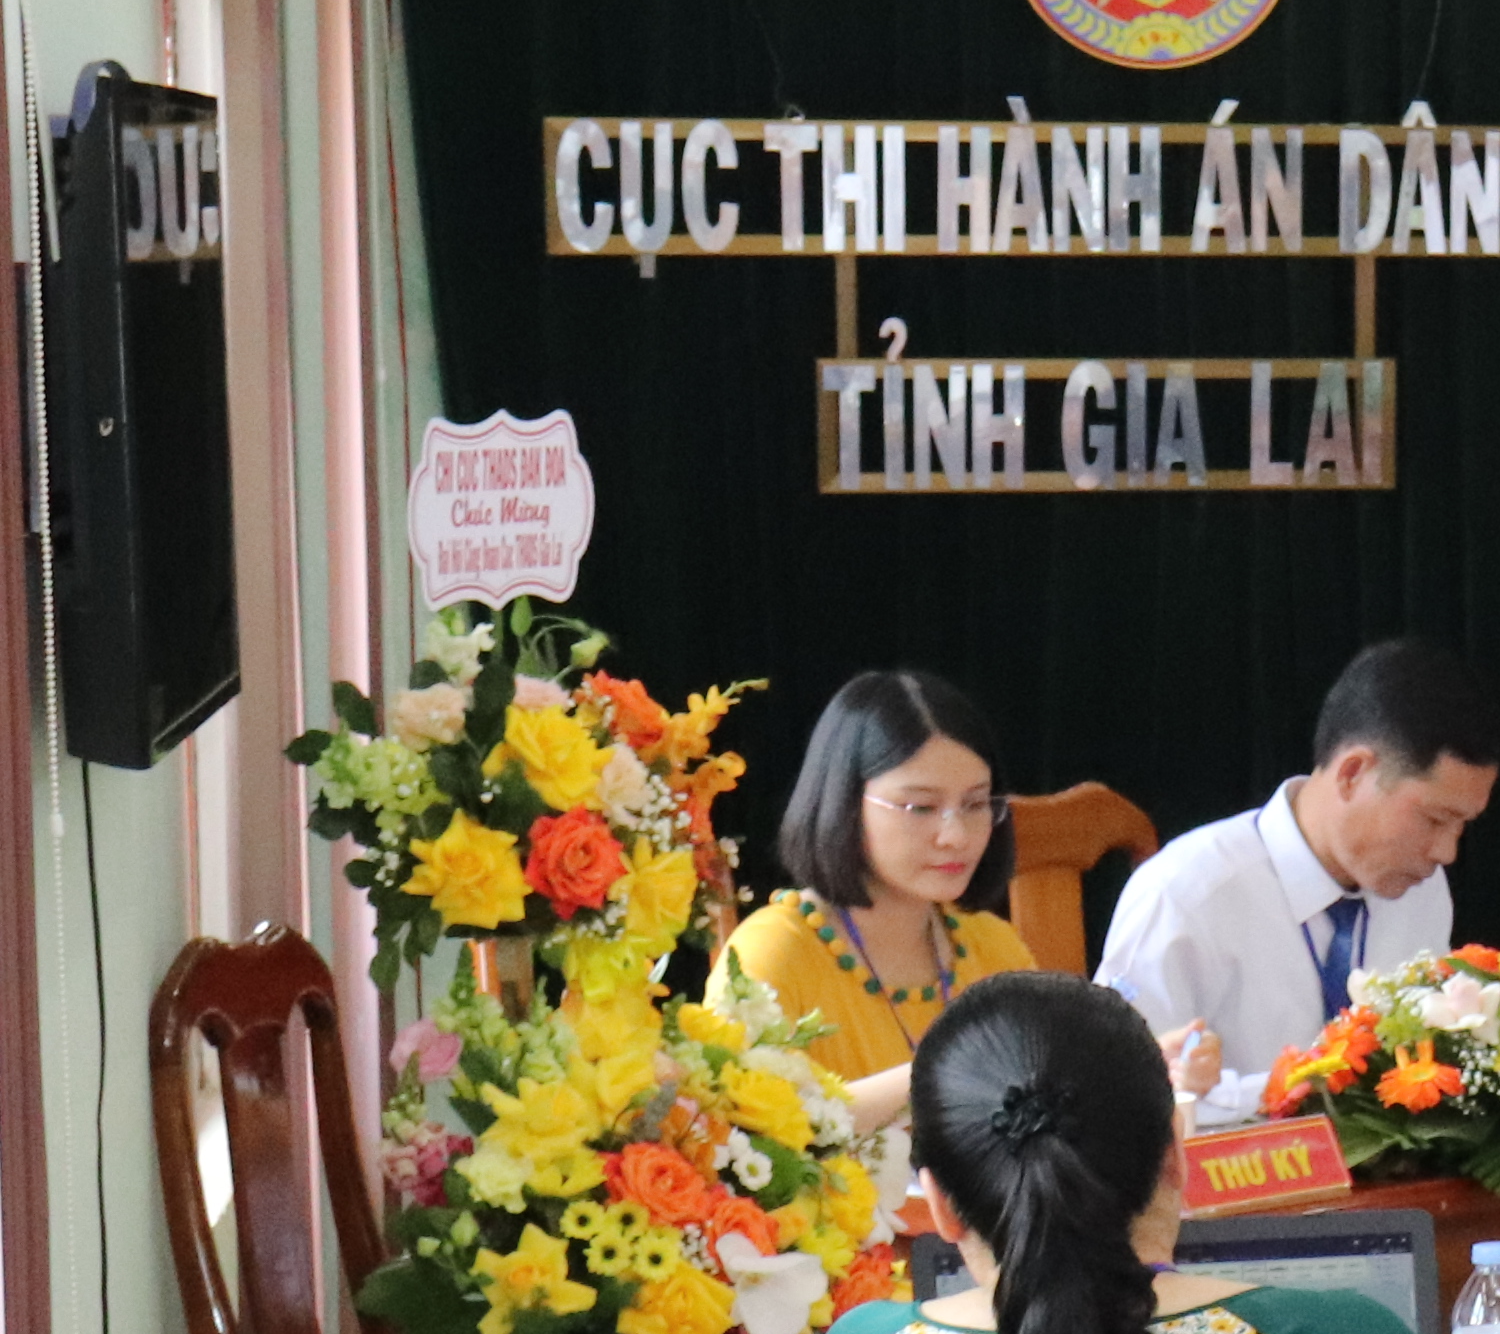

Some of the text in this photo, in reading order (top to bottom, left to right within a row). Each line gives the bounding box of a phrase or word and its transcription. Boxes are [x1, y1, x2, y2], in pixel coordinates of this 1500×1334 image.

[556, 118, 738, 278] CỤC
[764, 123, 906, 253] THI
[938, 95, 1163, 253] HÀNH
[1191, 99, 1304, 254] ÁN
[821, 317, 1384, 490] TỈNH GIA LAI
[1268, 1138, 1313, 1181] KÝ
